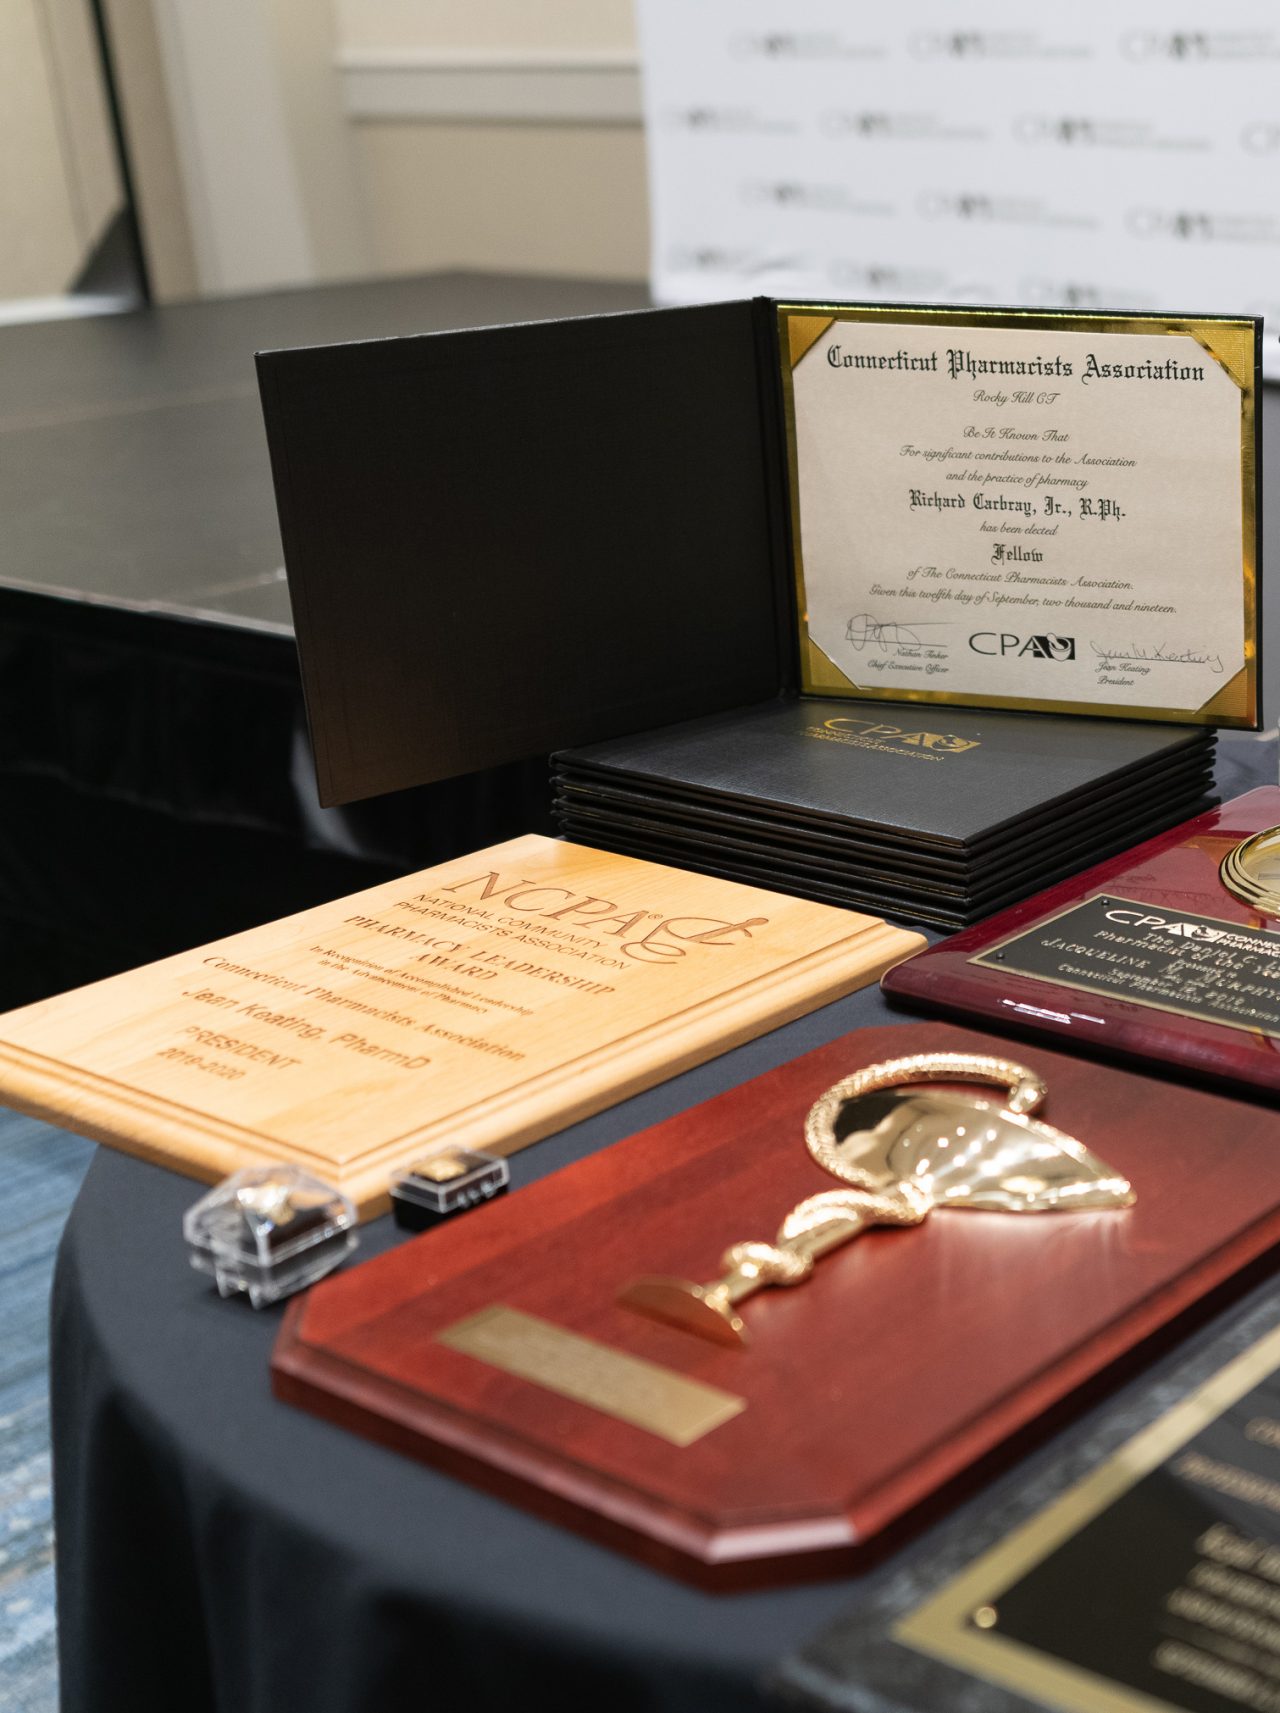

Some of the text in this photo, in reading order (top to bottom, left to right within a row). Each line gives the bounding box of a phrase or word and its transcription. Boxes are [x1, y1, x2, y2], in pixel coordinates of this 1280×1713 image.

[826, 344, 1205, 386] Connecticut Pharmacists Association
[973, 389, 1061, 407] Rocky Hill CT
[963, 425, 1070, 442] Be It Known That
[899, 445, 1138, 468] For significant contributions to the Association
[946, 470, 1088, 491] and the practice of pharmacy
[909, 488, 1127, 522] Richard Carbray, Jr., R.Ph.
[979, 521, 1060, 536] has been elected
[990, 542, 1044, 566] Fellow
[906, 566, 1135, 590] of The Connecticut Pharmacists Association.
[869, 583, 1178, 614] Given this twelfth day of September, two thousand and nineteen.
[968, 631, 1048, 659] CPA
[867, 659, 949, 675] Chief Executive Officer
[1097, 675, 1135, 687] President
[1118, 663, 1151, 676] Keating
[823, 717, 930, 748] CPA
[412, 893, 609, 949] NATIONAL COMMUNITY
[1105, 909, 1188, 937] CPA
[393, 901, 633, 970] PHARMACISTS ASSOCIATION
[1093, 929, 1187, 957] Pharmacist
[1142, 932, 1174, 946] The
[344, 915, 616, 996] PHARMACY LEADERSHIP
[408, 953, 499, 981] AWARD
[1040, 937, 1152, 970] JACQUELINE
[202, 955, 526, 1062] Connecticut Pharmacists Association
[471, 992, 534, 1017] Leadership
[182, 986, 433, 1070] Jean Keating, PharmD
[176, 1024, 303, 1071] PRESIDENT
[160, 1047, 247, 1081] 2019-2020
